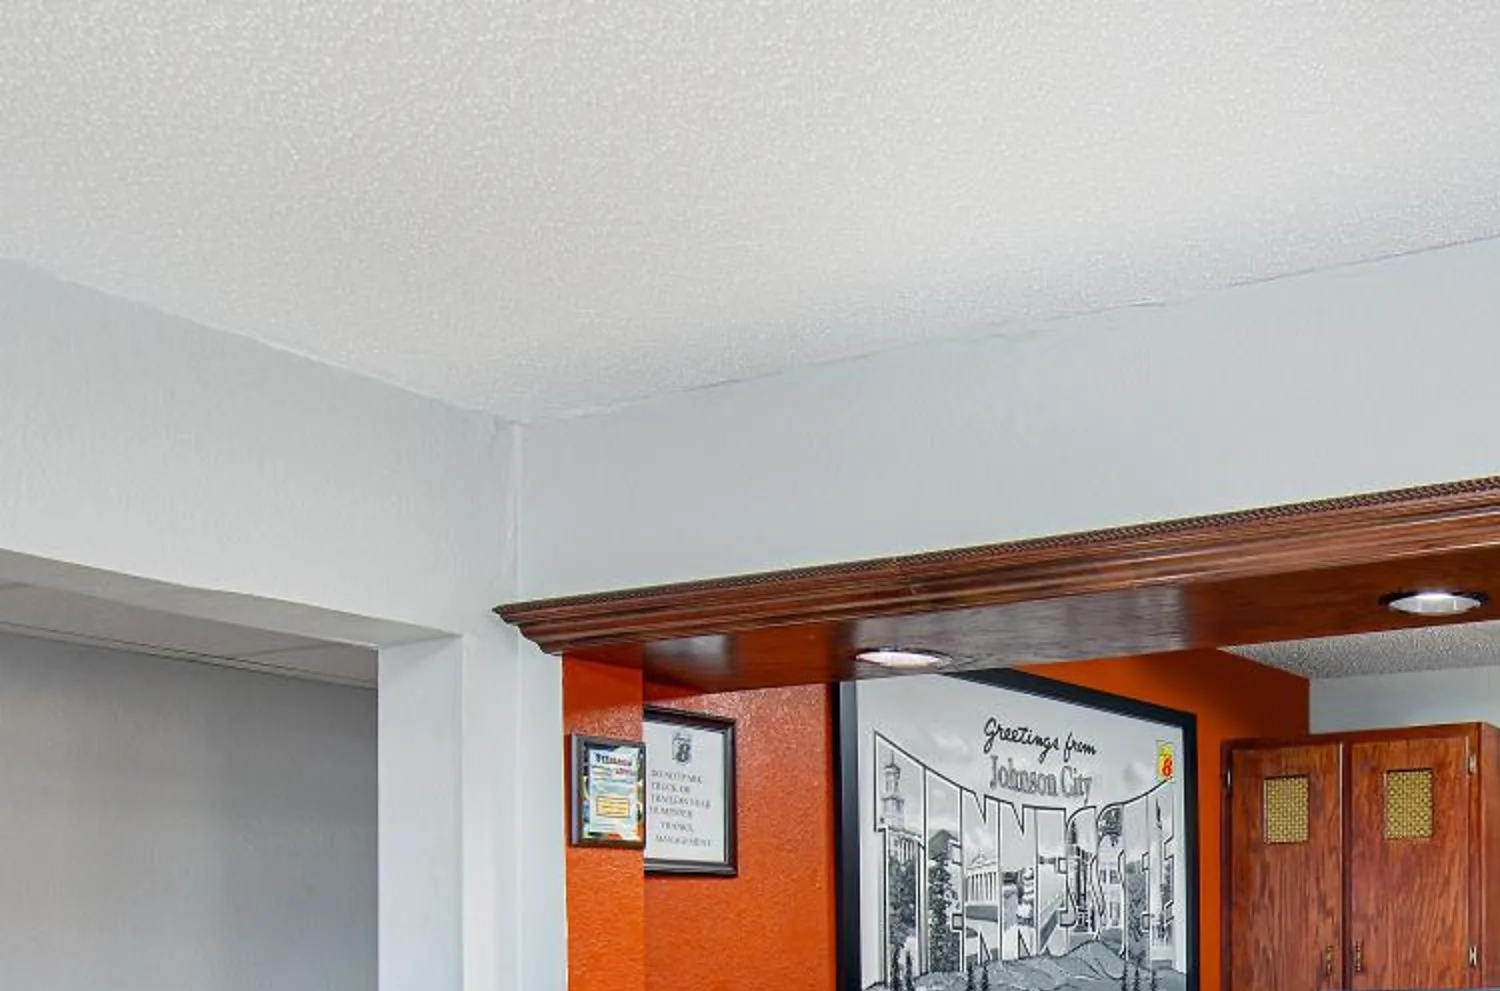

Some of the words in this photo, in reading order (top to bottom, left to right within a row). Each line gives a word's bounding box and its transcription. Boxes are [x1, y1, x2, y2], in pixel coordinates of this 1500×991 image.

[983, 716, 1060, 764] Greetings
[1064, 731, 1098, 763] from
[989, 754, 1059, 797] Johnson
[1061, 765, 1093, 804] City
[872, 729, 1176, 989] TENNESSEE
